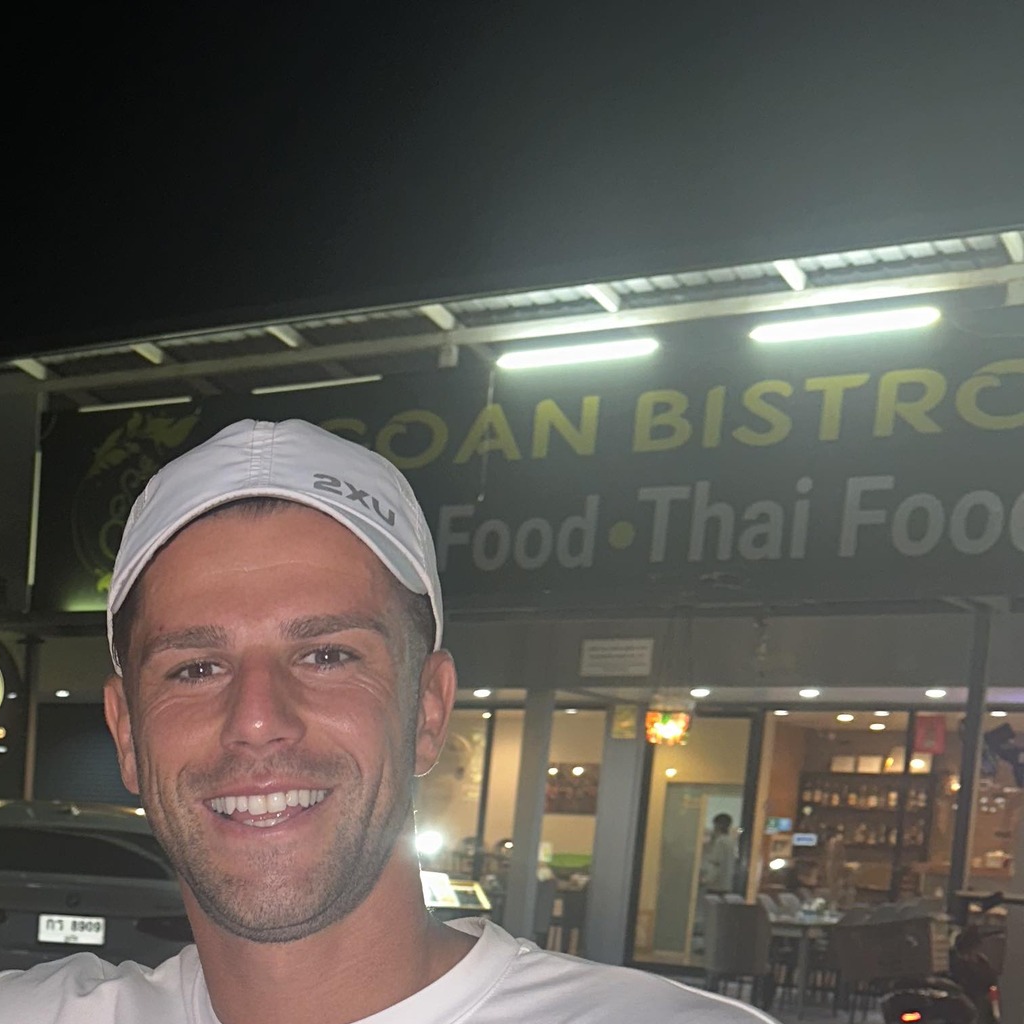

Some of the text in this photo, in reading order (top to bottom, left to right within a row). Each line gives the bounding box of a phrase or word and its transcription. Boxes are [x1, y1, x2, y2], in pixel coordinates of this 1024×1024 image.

[632, 358, 1024, 452] BISTRO
[313, 473, 395, 526] 2XU
[436, 474, 1024, 573] Food Thai Foo
